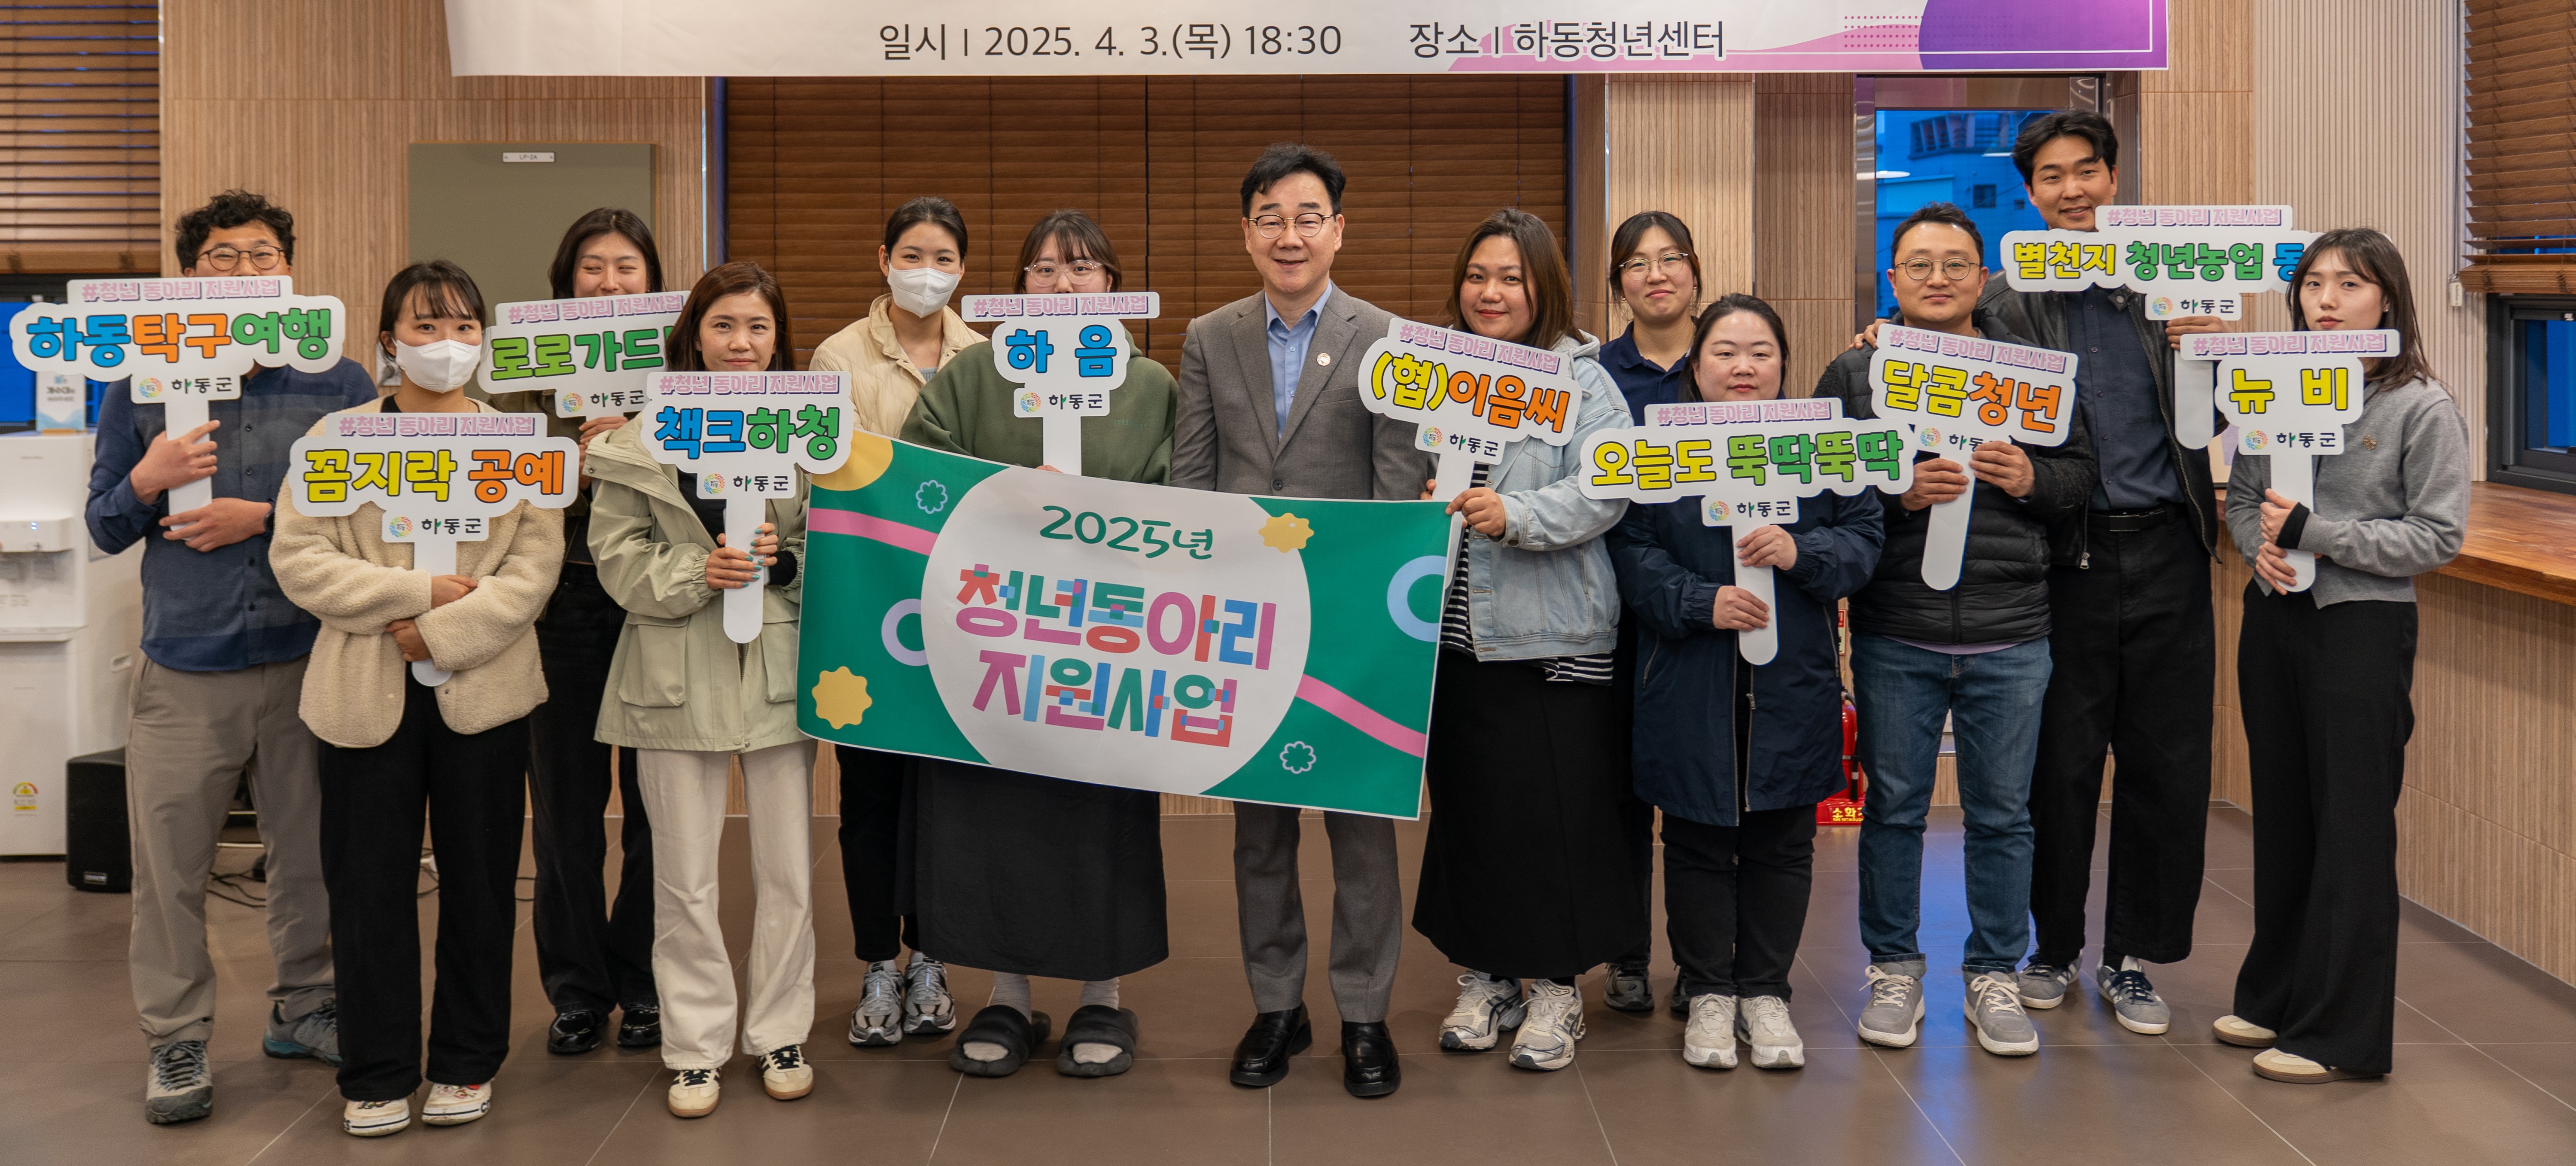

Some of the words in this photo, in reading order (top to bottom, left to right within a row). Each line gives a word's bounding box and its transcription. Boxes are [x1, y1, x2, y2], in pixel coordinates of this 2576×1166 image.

[880, 24, 946, 61] 일시
[984, 26, 1080, 58] 2025.
[1094, 26, 1124, 57] 4.
[1139, 24, 1232, 60] 3.(목)
[1245, 24, 1342, 55] 18:30
[1410, 21, 1480, 58] 장소
[1514, 21, 1723, 58] 하동청년센터
[2107, 208, 2156, 227] #청년
[2159, 208, 2210, 226] 동아리
[2213, 208, 2282, 226] 지원사업
[2013, 241, 2116, 281] 별천지
[2125, 240, 2264, 282] 청년농업
[82, 282, 140, 301] #청년
[143, 280, 202, 300] 동아리
[205, 279, 280, 299] 지원사업
[508, 303, 559, 324] #청년
[561, 299, 613, 320] 동아리
[616, 295, 684, 317] 지원사업
[974, 297, 1023, 317] #청년
[1026, 296, 1078, 317] 동아리
[1080, 295, 1149, 315] 지원사업
[2180, 298, 2235, 314] 하동군
[26, 307, 332, 368] 하동탁구여행
[1399, 324, 1448, 349] #청년
[1448, 333, 1497, 362] 동아리
[1497, 344, 1561, 375] 지원사업
[2193, 335, 2247, 356] #청년
[2250, 335, 2307, 355] 동아리
[2310, 333, 2387, 354] 지원사업
[490, 325, 675, 381] 로로가드
[1889, 329, 1940, 353] #청년
[1941, 337, 1996, 362] 동아리
[1996, 345, 2067, 374] 지원사업
[171, 377, 232, 394] 하동군
[659, 374, 711, 395] #청년
[713, 374, 767, 395] 동아리
[770, 374, 840, 394] 지원사업
[1371, 350, 1571, 434] (협)이음씨
[1882, 359, 2062, 434] 달콤청년
[590, 390, 644, 408] 하동군
[1048, 393, 1103, 410] 하동군
[339, 417, 396, 436] #청년
[399, 416, 457, 436] 동아리
[460, 416, 536, 436] 지원사업
[1657, 406, 1707, 426] #청년
[1709, 404, 1762, 425] 동아리
[1763, 401, 1832, 423] 지원사업
[654, 404, 840, 461] 책크하청
[1449, 433, 1498, 457] 하동군
[1949, 434, 1993, 452] 하동
[2275, 432, 2336, 448] 하동군
[1591, 438, 1717, 491] 오늘도
[1726, 430, 1904, 487] 뚝딱뚝딱
[303, 449, 457, 503] 꼼지락
[468, 449, 565, 504] 공예
[733, 475, 789, 492] 하동군
[1736, 500, 1791, 518] 하동군
[421, 518, 482, 535] 하동군
[1039, 505, 1213, 560] 2025년
[956, 563, 1277, 671] 청년동아리
[972, 649, 1238, 748] 지원사업
